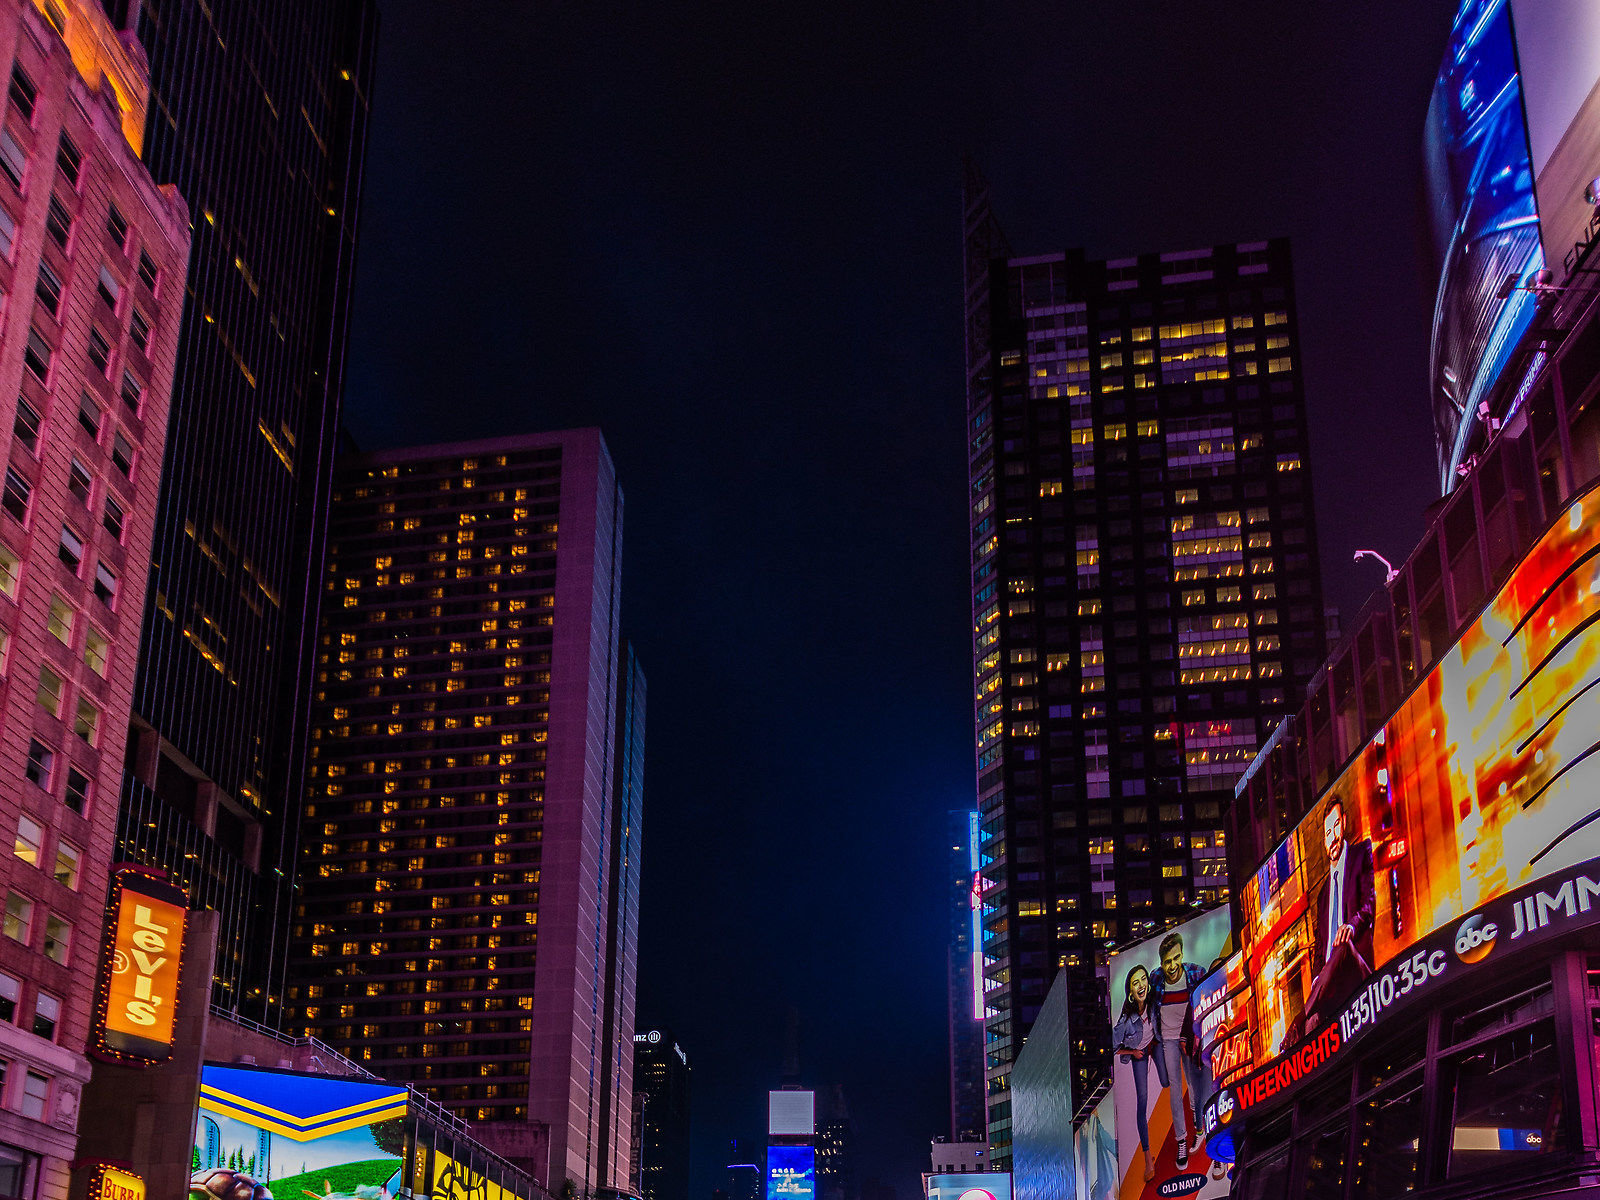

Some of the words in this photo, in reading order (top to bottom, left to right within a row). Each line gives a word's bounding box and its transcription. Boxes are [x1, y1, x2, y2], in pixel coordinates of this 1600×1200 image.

[1236, 1022, 1340, 1110] WEEKNIGHTS
[1455, 922, 1498, 954] abc
[1526, 1135, 1542, 1143] abc
[1162, 1182, 1178, 1195] OLD
[1178, 1176, 1202, 1191] NAVY
